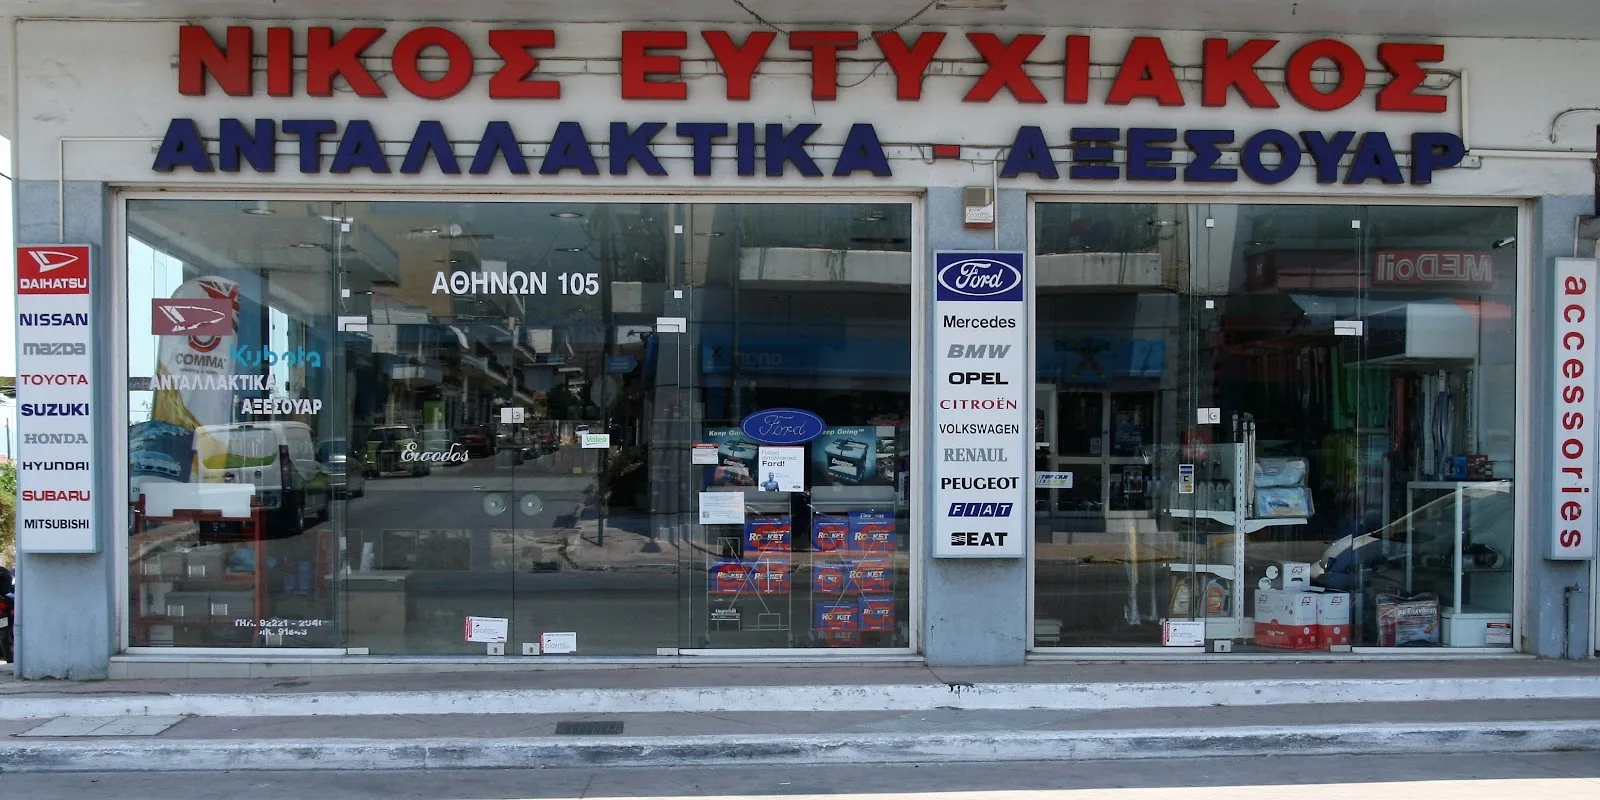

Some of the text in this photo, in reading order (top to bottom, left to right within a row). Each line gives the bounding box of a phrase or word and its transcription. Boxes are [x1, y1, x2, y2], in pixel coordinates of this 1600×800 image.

[178, 25, 1447, 112] ΝΙΚΟΣ ΕΥΤΥΧΙΑΚΟΣ
[151, 118, 892, 178] ΑΝΤΑΛΛΑΚΤΙΚΑ
[1000, 125, 1465, 185] ΑΞΕΣΟΥΑΡ
[955, 262, 1003, 288] Ford
[20, 278, 87, 289] DAIHATSU
[431, 271, 599, 295] ΑΘΗΝΩΝ 105
[20, 313, 88, 326] NISSAN
[943, 315, 1016, 328] Mercedes
[229, 344, 321, 367] Kubota
[947, 344, 1011, 358] BMW
[21, 374, 88, 386] TOYOTA
[149, 375, 276, 391] ΑΝΤΑΛΛΑΚΤΙΚΑ
[949, 372, 1008, 385] OPEL
[21, 403, 89, 417] SUZUKI
[241, 398, 322, 414] ΑΞΕΣΟΥΑΡ
[939, 397, 1017, 410] CITROËN
[1560, 275, 1589, 548] accessories
[759, 415, 805, 436] Ford
[939, 423, 1019, 434] VOLKSWAGEN
[24, 433, 88, 444] HONDA
[943, 448, 1007, 462] RENAUL
[23, 461, 89, 471] HYUNDAI
[941, 477, 1019, 490] PEUGEOT
[22, 490, 90, 501] SUBARU
[950, 504, 1011, 516] FIAT
[24, 519, 89, 529] MITSUBISHI
[951, 532, 1008, 546] SEAT
